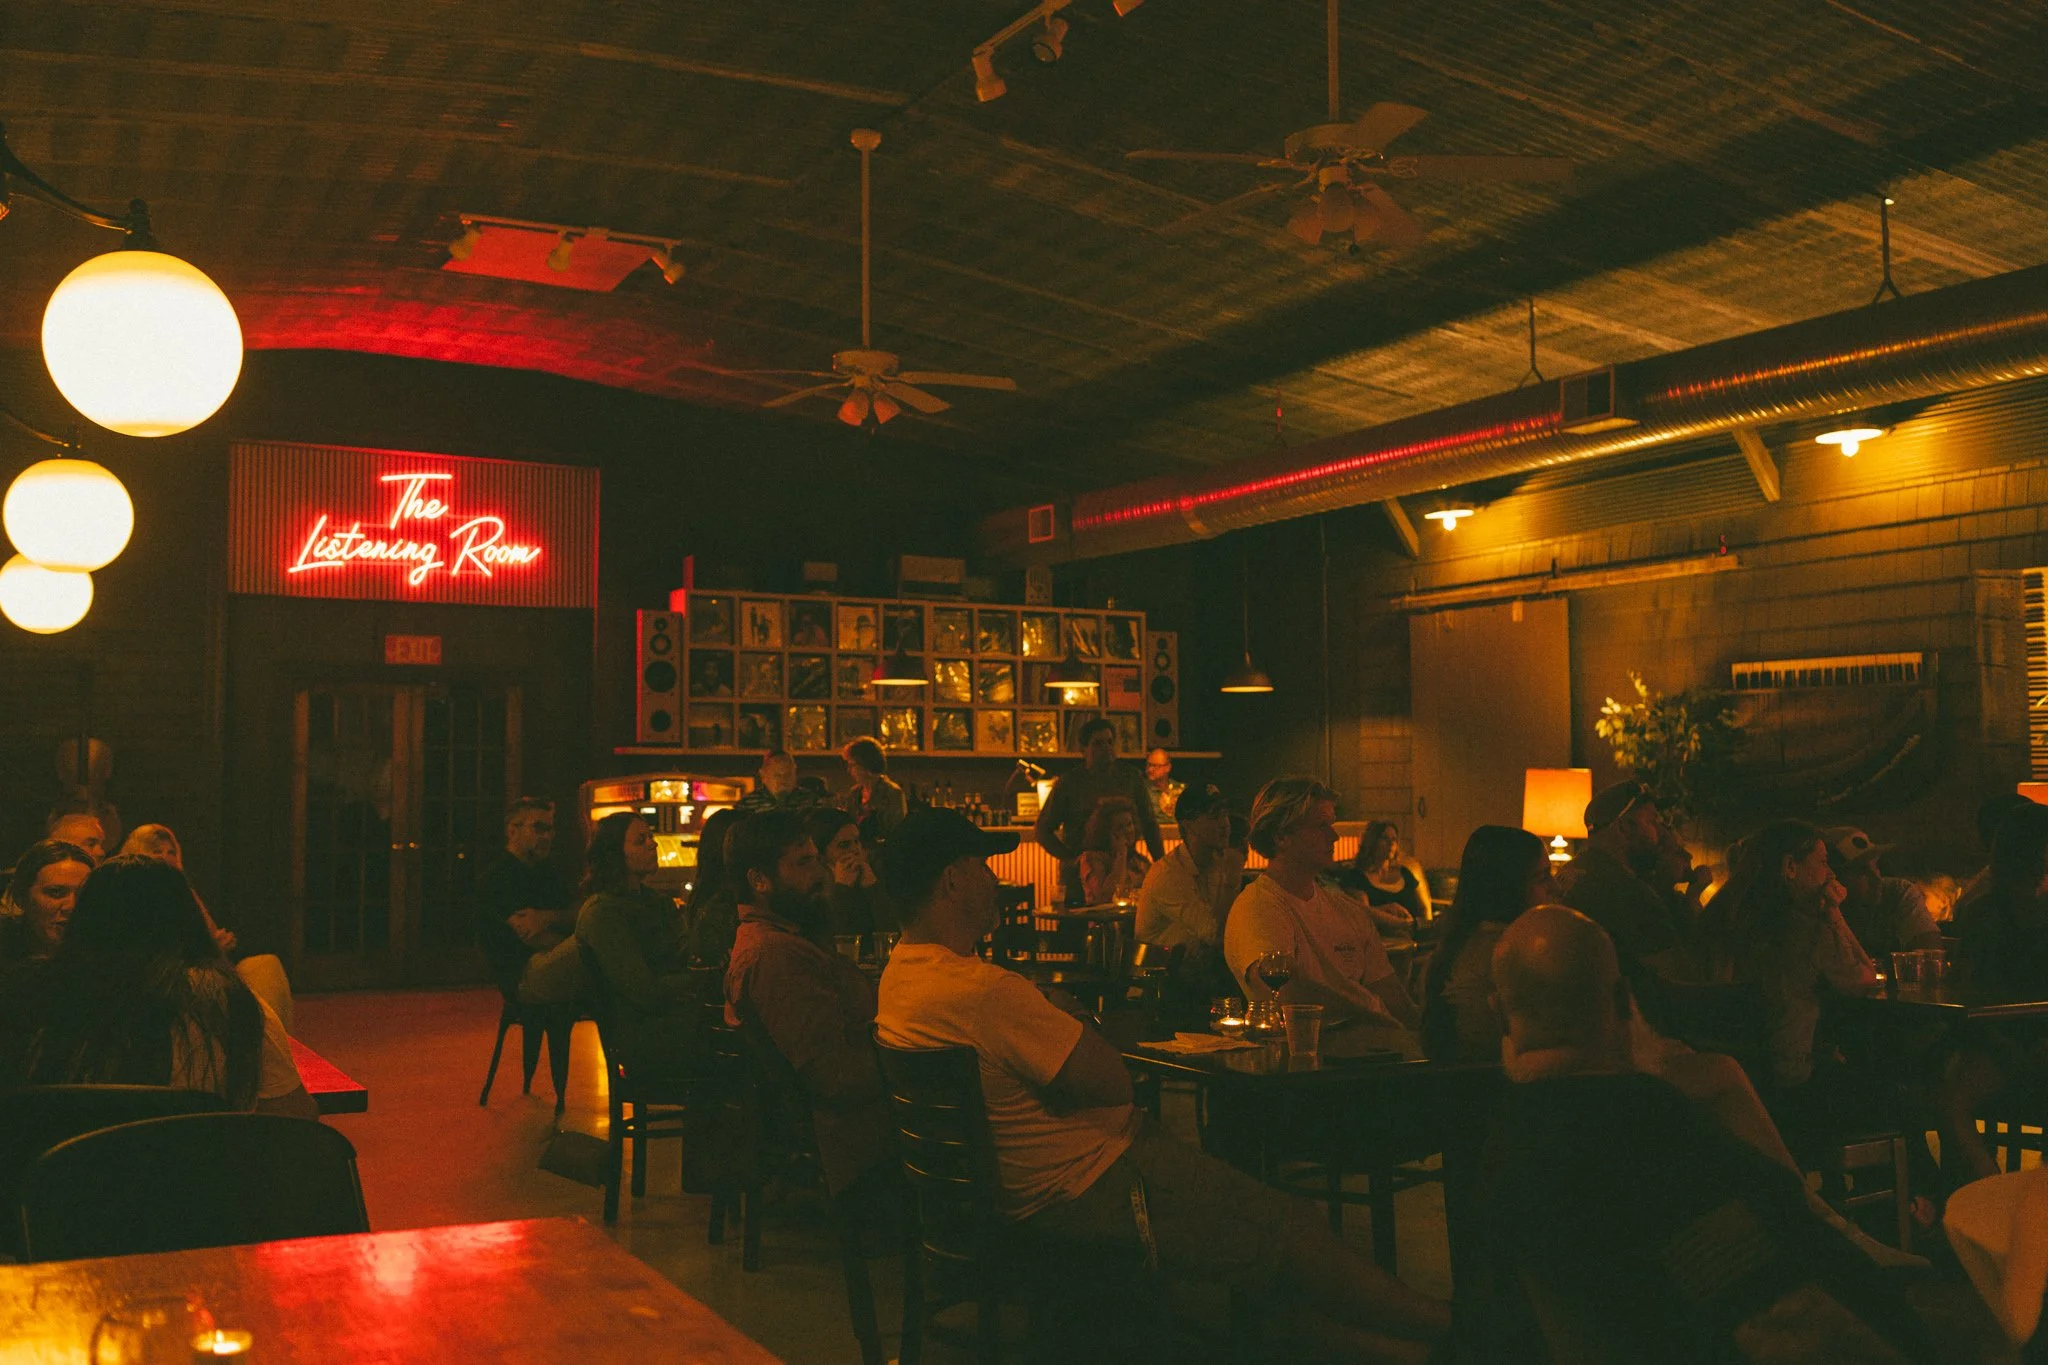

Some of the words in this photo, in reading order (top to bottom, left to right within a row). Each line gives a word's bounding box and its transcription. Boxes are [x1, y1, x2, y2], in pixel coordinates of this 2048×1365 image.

[381, 473, 453, 530] The
[287, 514, 445, 586] Listening
[449, 516, 541, 577] Room
[396, 638, 434, 661] EXIT
